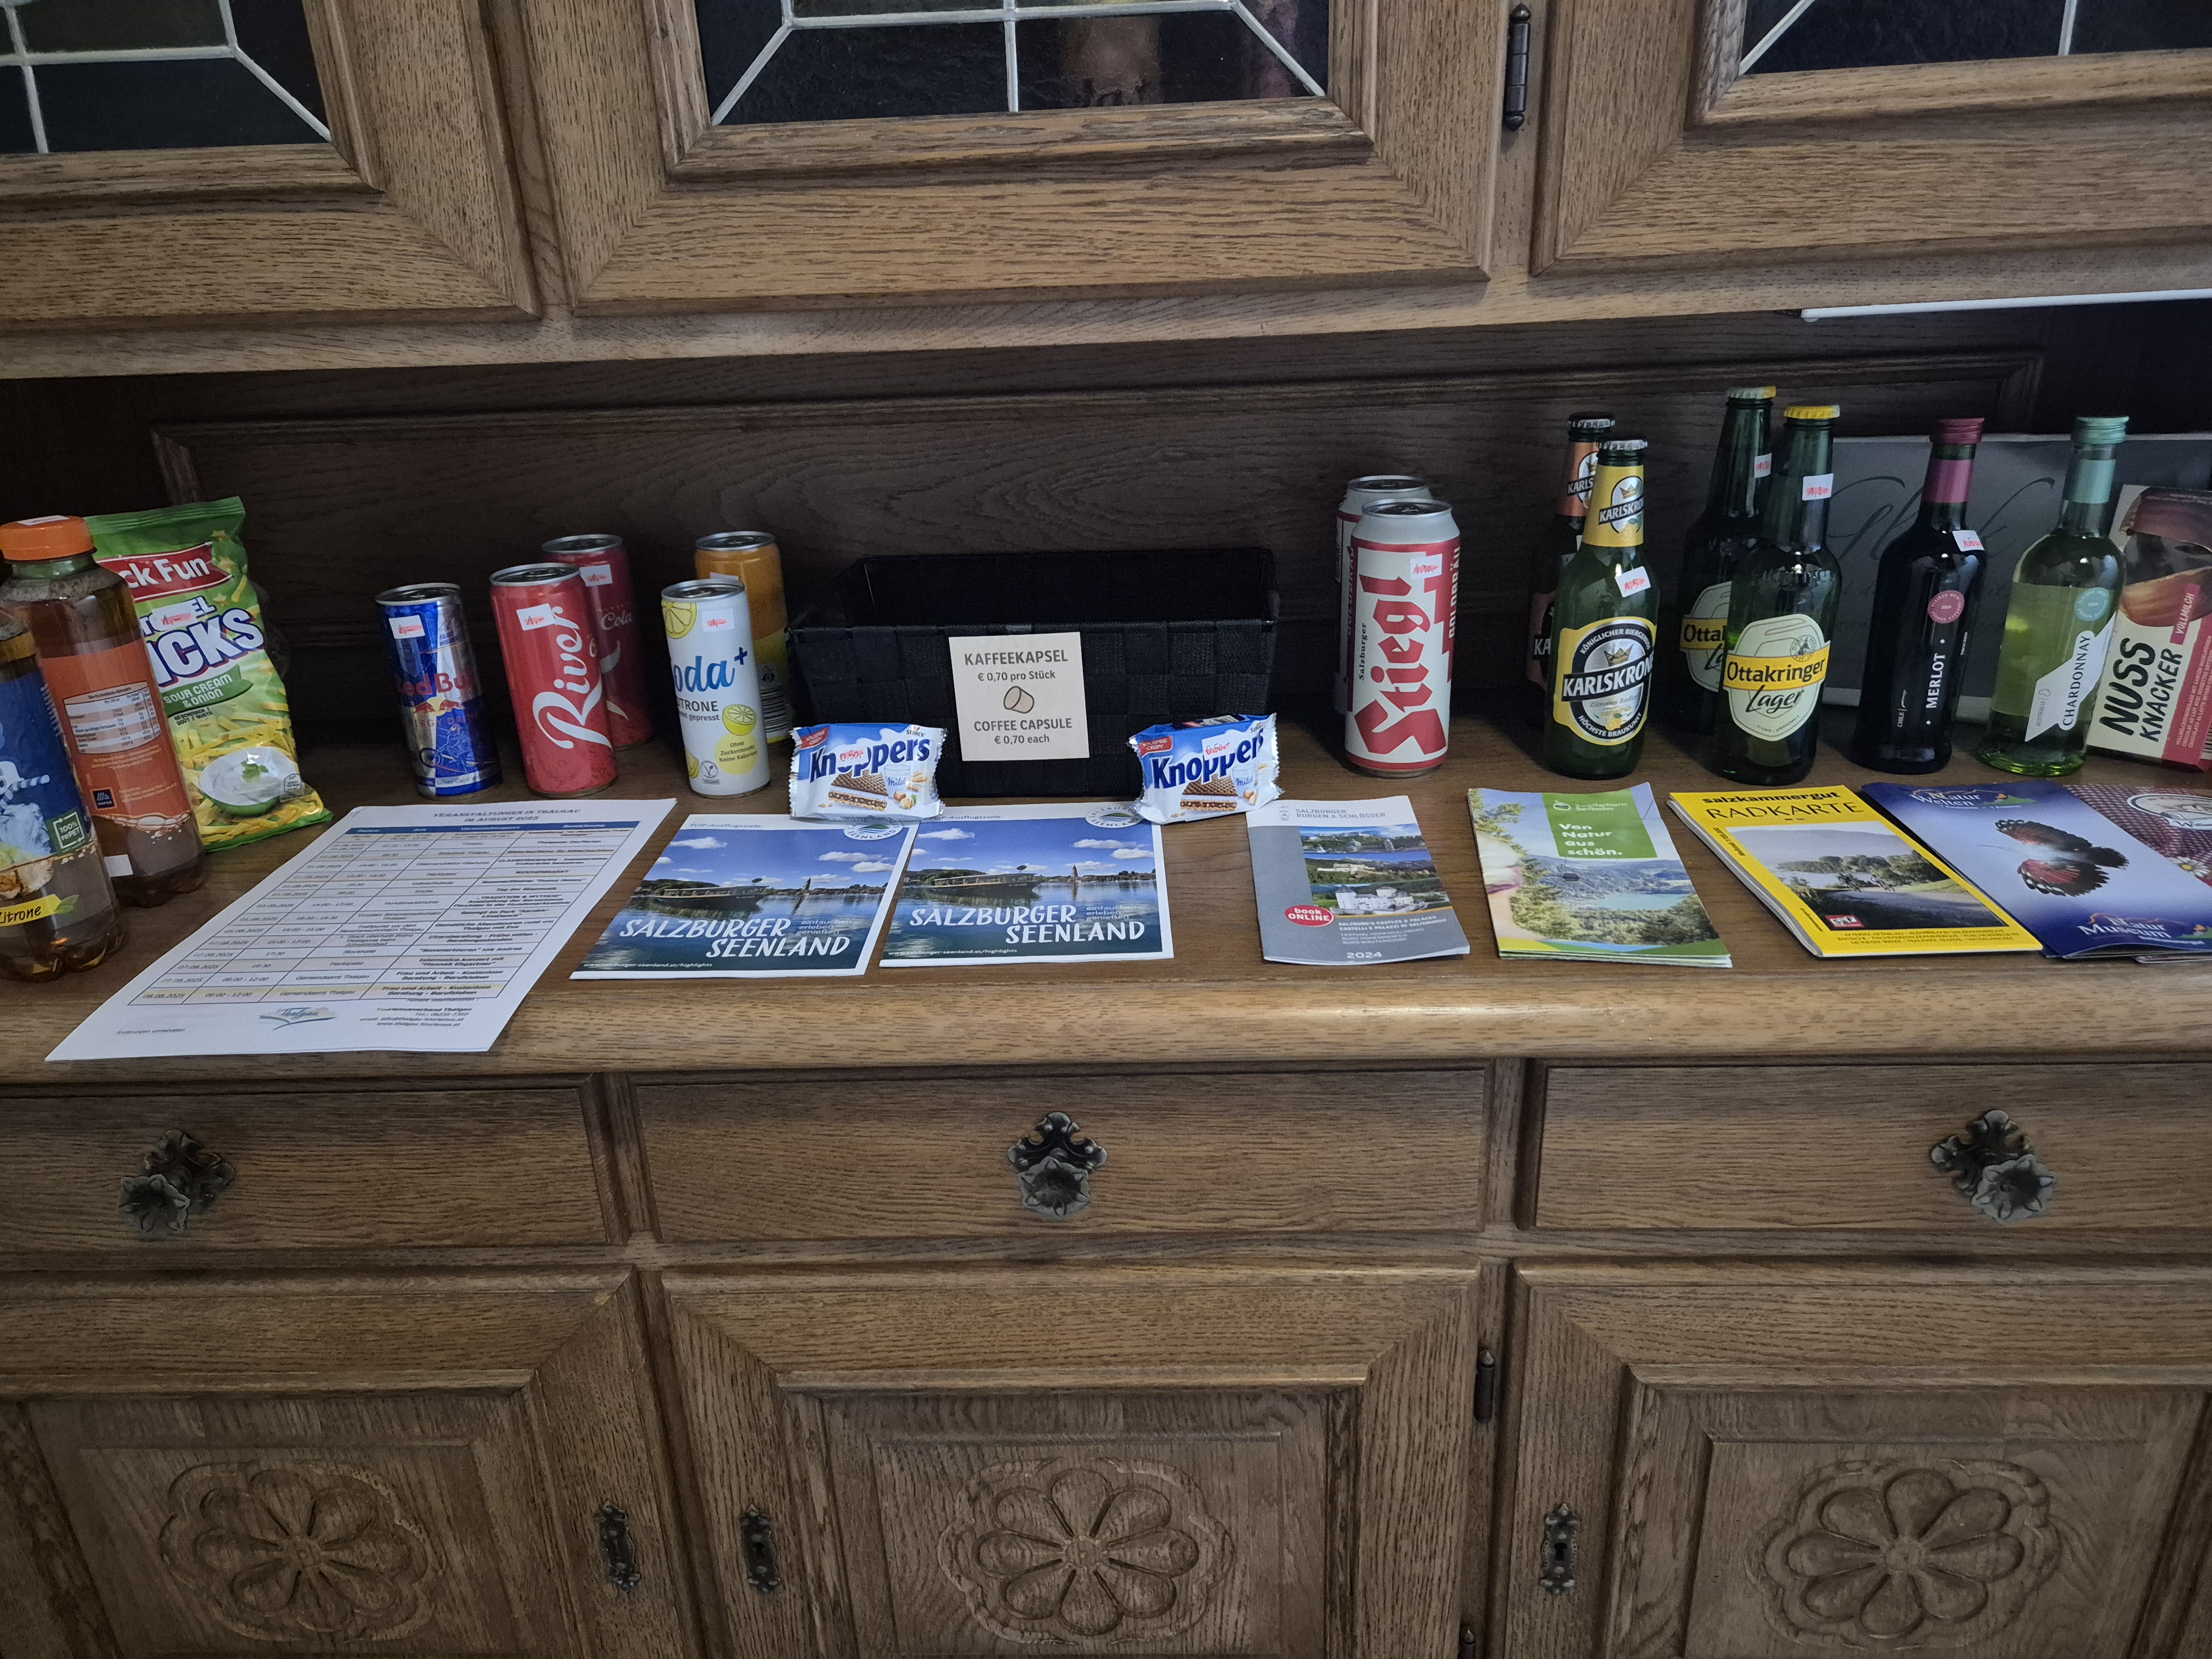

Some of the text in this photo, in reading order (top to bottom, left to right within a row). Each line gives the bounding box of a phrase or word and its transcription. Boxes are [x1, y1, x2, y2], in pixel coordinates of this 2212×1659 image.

[1567, 477, 1594, 495] KARLS
[1599, 497, 1644, 523] KARLSKRO
[153, 558, 211, 583] Fun
[601, 610, 633, 630] Cola
[2176, 592, 2195, 635] VOLLMILCH
[146, 607, 265, 687] ICKS
[1579, 628, 1624, 655] KÖNIGLICHER
[1625, 628, 1651, 651] BIERGENUSS
[964, 649, 1068, 666] KAFFEEKAPSEL
[1359, 623, 1368, 681] Salzburger
[1354, 573, 1447, 755] Stiegl
[1727, 657, 1826, 683] Ottakringer
[435, 671, 476, 693] Bu
[533, 606, 613, 750] River
[978, 670, 1056, 682] € 0,70 pro Stück
[1563, 650, 1654, 697] KARLSKRON
[1926, 653, 1946, 709] MERLOT
[2063, 635, 2091, 727] CHARDONNAY
[163, 674, 233, 704] SOUR CREAM
[2099, 638, 2156, 736] NUSS
[2140, 648, 2183, 743] KNACKER
[183, 688, 224, 708] & ONION
[1590, 699, 1618, 708] Zitronen
[1746, 685, 1804, 714] Lager
[174, 707, 206, 721] GESCHMACK
[196, 711, 213, 719] GUSTO
[688, 712, 721, 722] gepresst
[1897, 711, 1905, 728] CHILE
[2036, 701, 2046, 727] AUSTRALIA
[974, 718, 1073, 732] COFFEE CAPSULE
[1578, 712, 1642, 737] HÖCHSTE BRAUKUNST
[994, 734, 1050, 745] € 0,70 each
[1142, 737, 1167, 747] KNUSPRIG
[720, 744, 755, 756] Zuckerzusatz
[737, 750, 758, 761] Kalorien
[1702, 791, 1841, 804] salzkammergut
[1909, 794, 1975, 806] Welten
[1926, 792, 1981, 801] Natur
[1705, 802, 1864, 819] RADKARTE
[59, 821, 79, 833] 100%
[1090, 815, 1139, 827] SEENLAND
[61, 827, 81, 841] rePET
[848, 830, 896, 839] SEENLAND
[1567, 848, 1623, 856] schön.
[909, 905, 1077, 927] SALZBURGER
[1287, 912, 1330, 922] ONLINE
[1294, 907, 1322, 915] book
[619, 917, 792, 938] SALZBURGER
[2077, 924, 2172, 939] Museum
[2103, 916, 2166, 931] Natur
[1005, 921, 1145, 945] SEENLAND
[705, 936, 851, 958] SEENLAND
[279, 1007, 320, 1020] Thalgau
